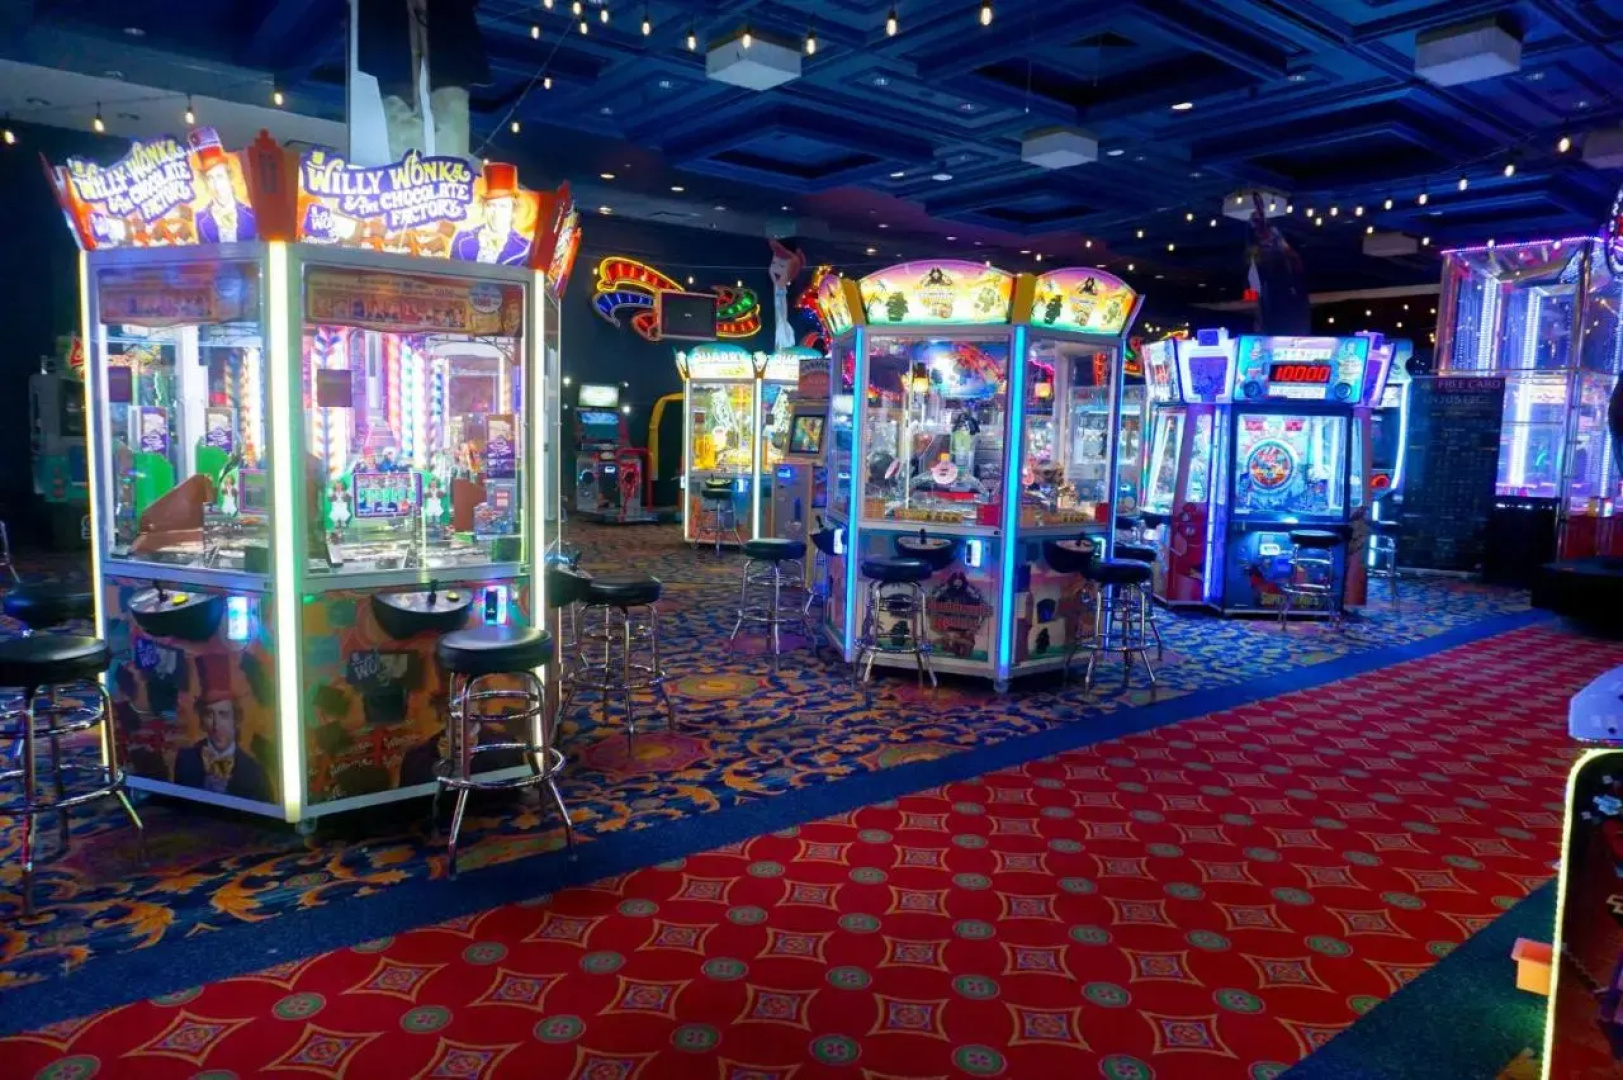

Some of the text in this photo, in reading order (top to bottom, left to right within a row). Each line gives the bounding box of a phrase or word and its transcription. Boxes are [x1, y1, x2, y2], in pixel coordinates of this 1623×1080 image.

[70, 142, 187, 198] WILLY WONKA
[307, 152, 471, 194] WILLY WONKA
[380, 183, 470, 209] CHOCOLATE
[391, 199, 466, 226] FACTORY
[1276, 365, 1331, 382] 10000
[1438, 378, 1501, 389] FREE CARD
